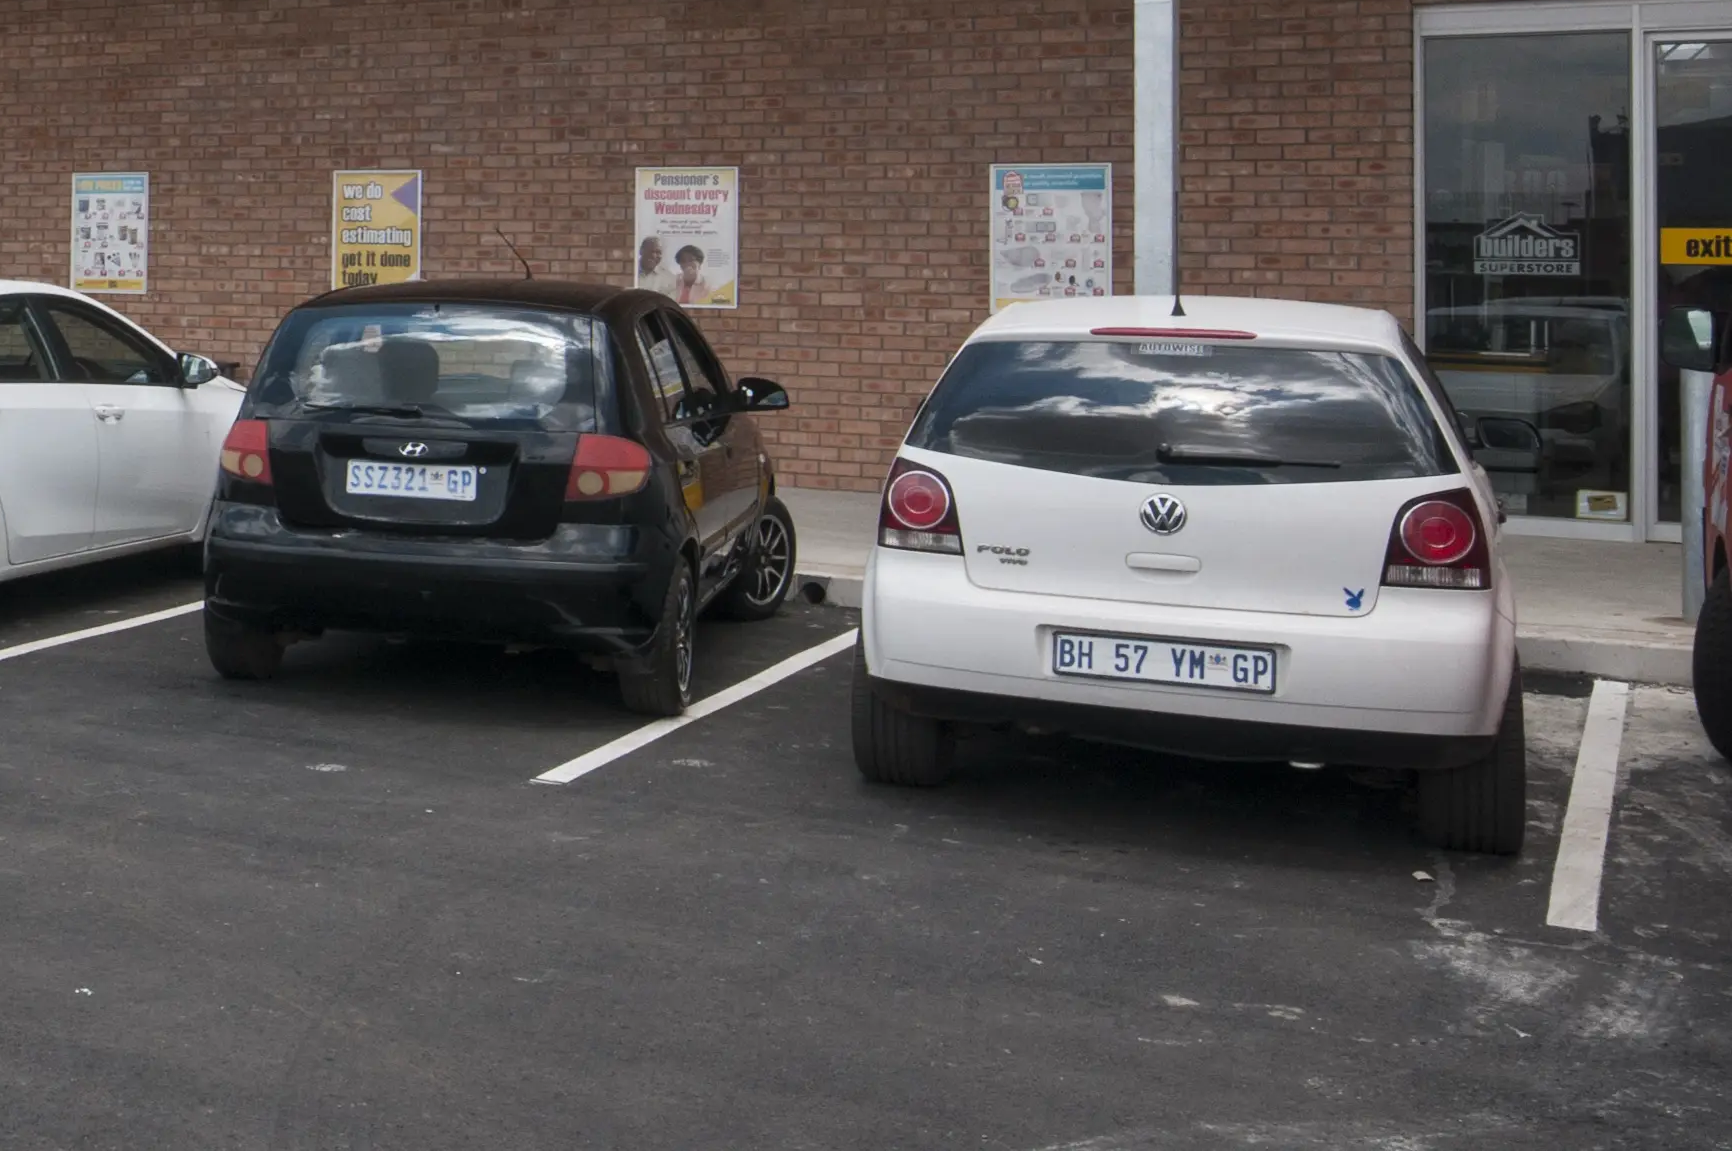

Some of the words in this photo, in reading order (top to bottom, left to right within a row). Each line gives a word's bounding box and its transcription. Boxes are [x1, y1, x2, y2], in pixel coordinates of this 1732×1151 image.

[343, 184, 363, 199] we
[366, 181, 382, 199] do
[644, 188, 691, 200] discount
[694, 190, 729, 203] every
[343, 204, 372, 221] cost
[654, 202, 718, 217] Wednesday
[341, 227, 412, 246] estimating
[1480, 235, 1575, 258] builders
[1686, 235, 1732, 258] exit
[342, 252, 362, 268] get
[366, 250, 376, 267] it
[380, 251, 411, 267] done
[1479, 263, 1573, 273] SUPERSTORE
[342, 270, 377, 285] today
[350, 464, 429, 492] SSZ321
[447, 470, 472, 494] GP
[977, 544, 1031, 557] POLO
[1059, 638, 1093, 669] BH
[1114, 643, 1149, 674] 57
[1171, 648, 1205, 679] YM
[1232, 654, 1268, 684] GP
